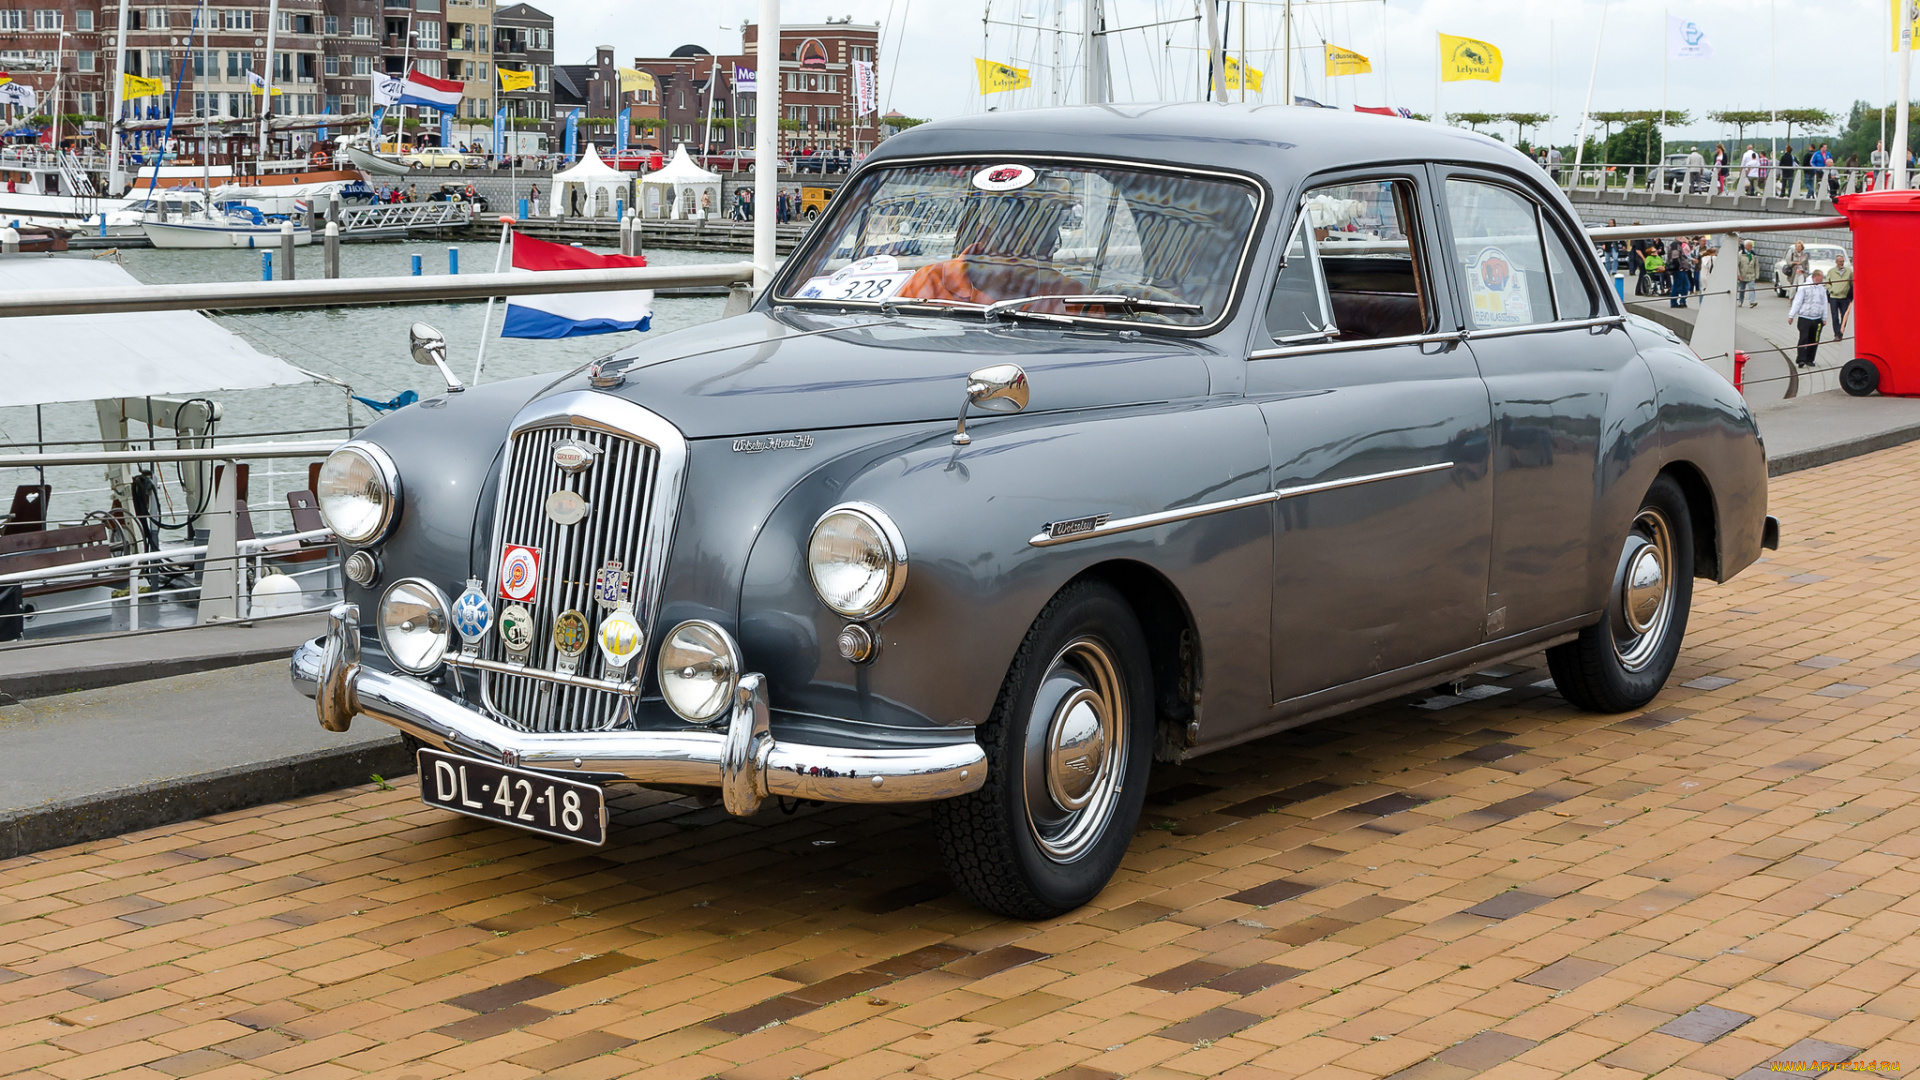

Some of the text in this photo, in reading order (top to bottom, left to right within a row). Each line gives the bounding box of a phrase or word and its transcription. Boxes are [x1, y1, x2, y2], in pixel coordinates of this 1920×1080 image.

[1457, 65, 1489, 75] Lelystad
[837, 279, 892, 300] 328
[732, 439, 767, 454] Wolseley
[1057, 521, 1093, 535] Wolseley
[435, 760, 584, 831] DL-42-18
